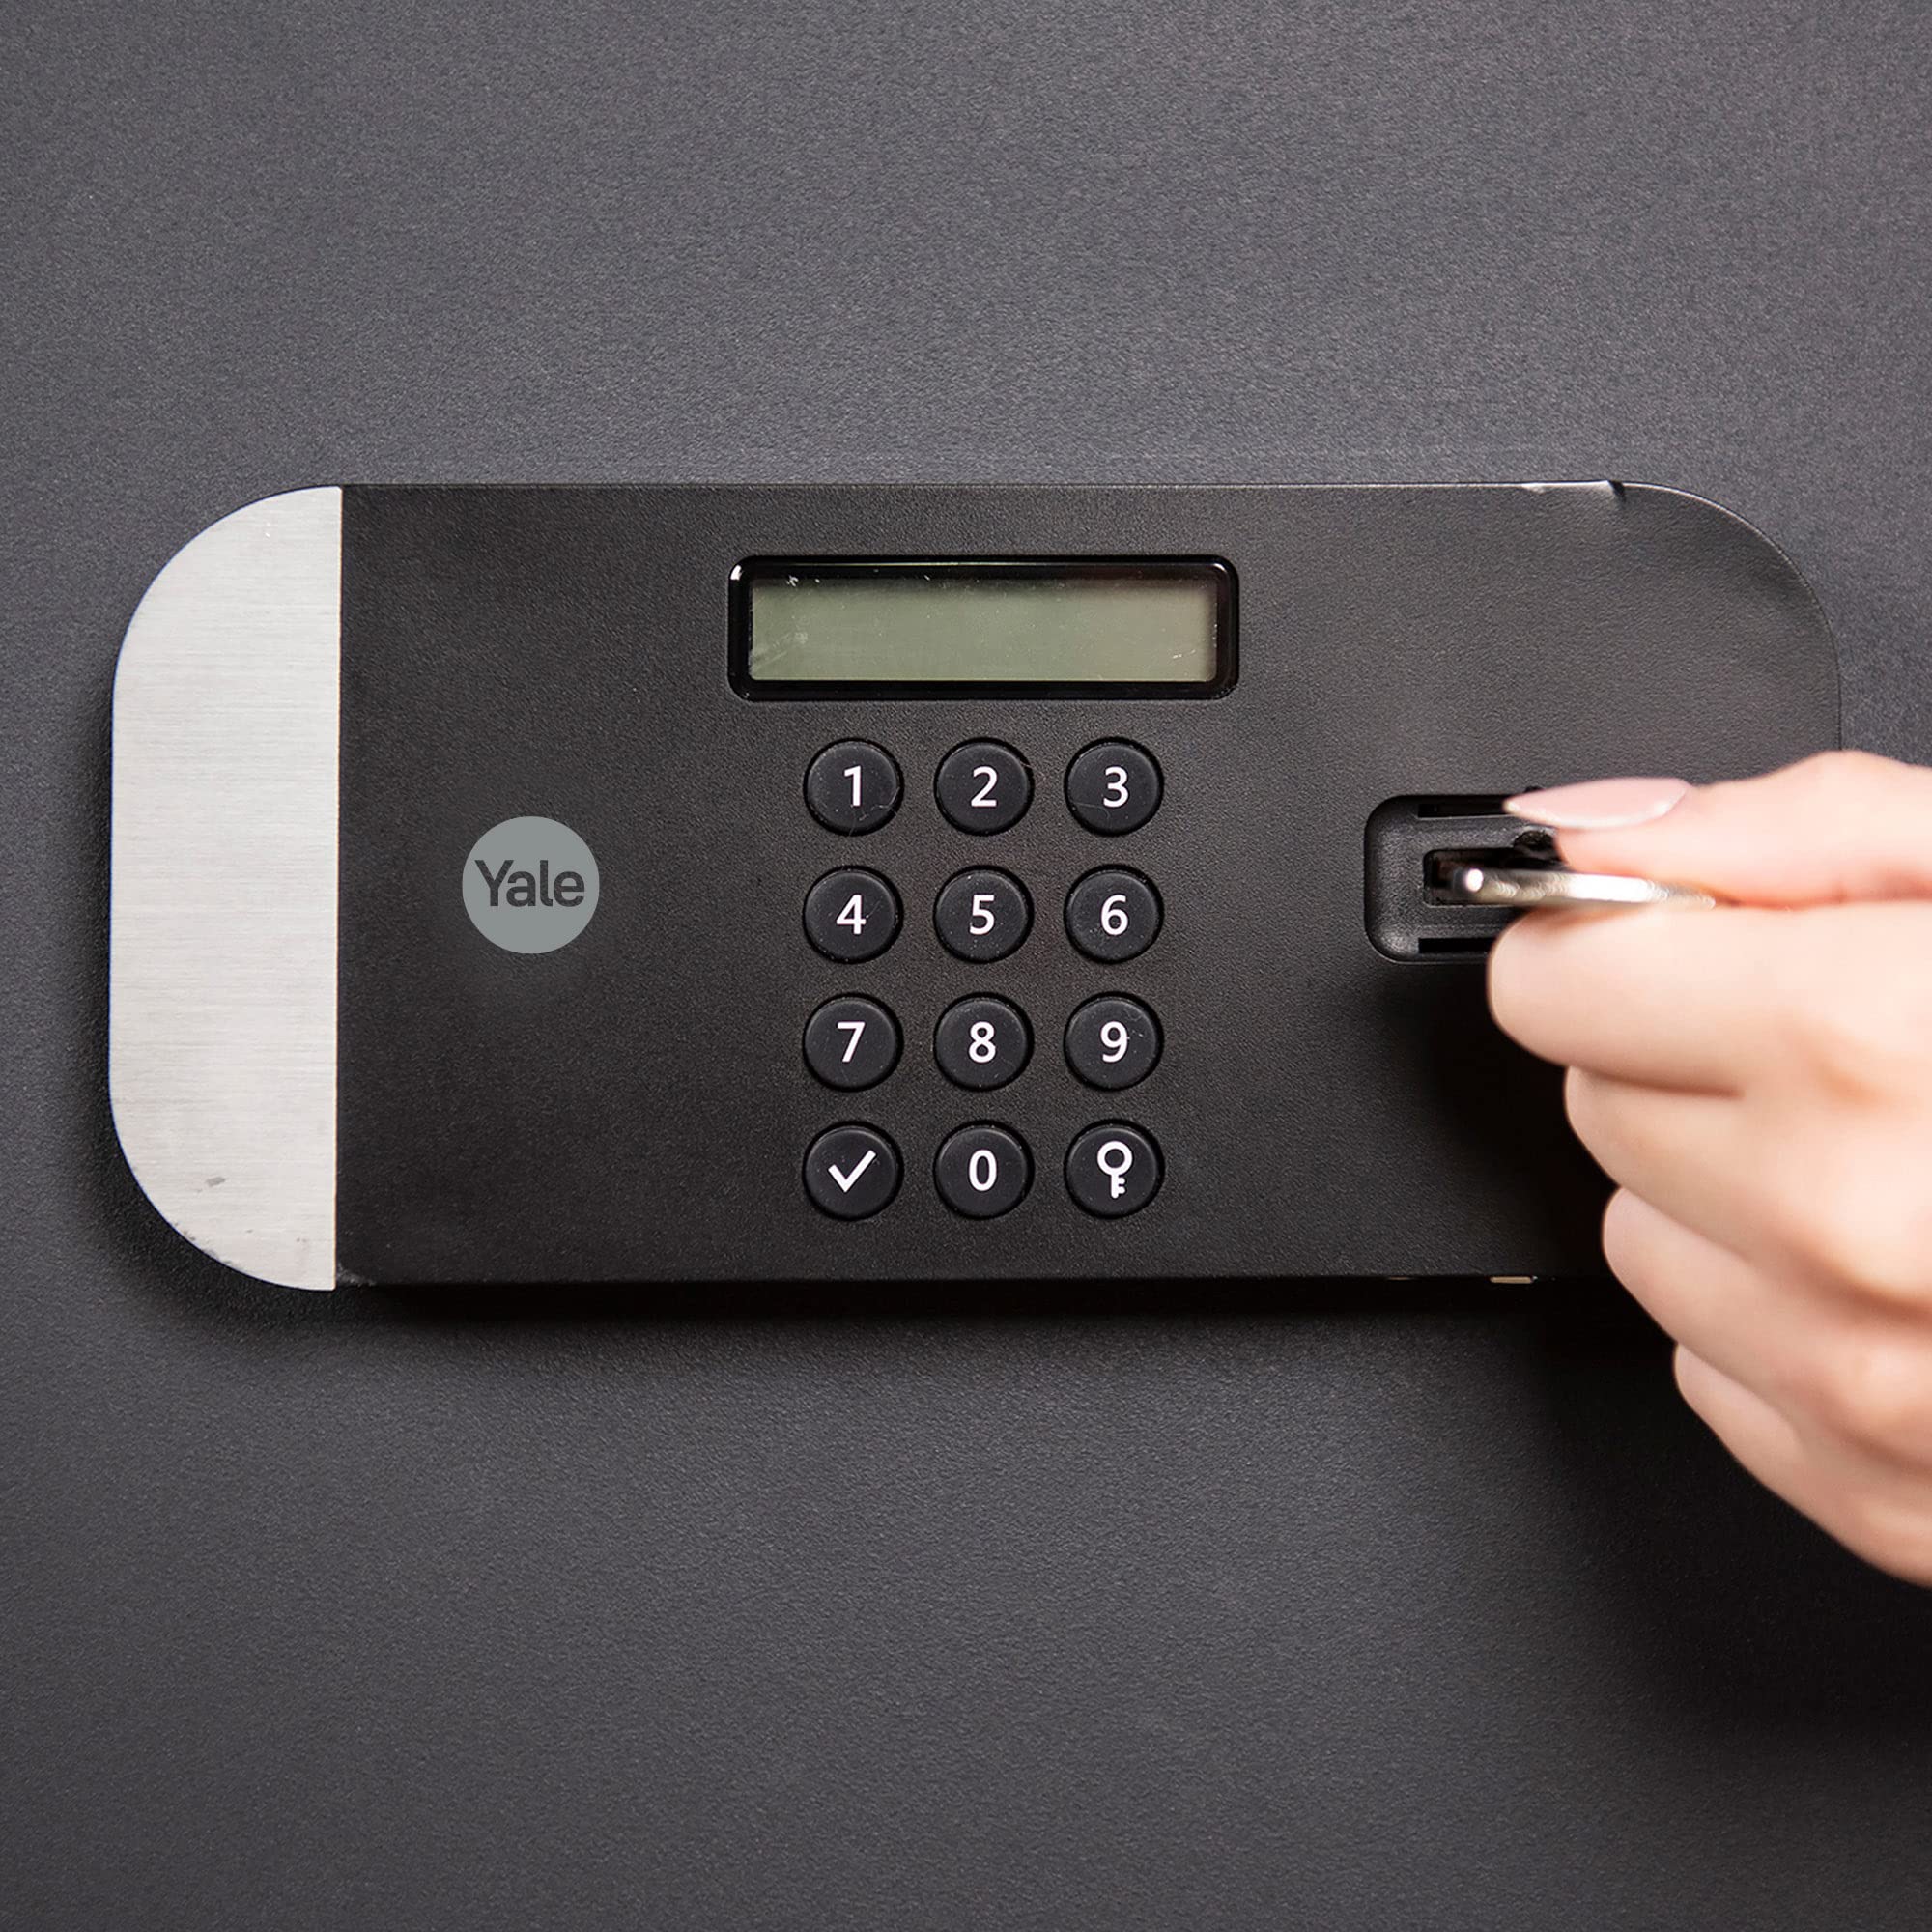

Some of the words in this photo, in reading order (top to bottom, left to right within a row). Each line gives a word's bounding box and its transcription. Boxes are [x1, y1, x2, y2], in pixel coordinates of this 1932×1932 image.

[843, 765, 862, 807] 1
[970, 765, 998, 808] 2
[1103, 766, 1129, 808] 3
[474, 859, 585, 908] Yale
[836, 894, 867, 935] 4
[969, 894, 995, 935] 5
[1100, 895, 1128, 936] 6
[837, 1021, 866, 1063] 7
[968, 1021, 997, 1064] 8
[1100, 1020, 1128, 1063] 9
[968, 1149, 997, 1192] 0
